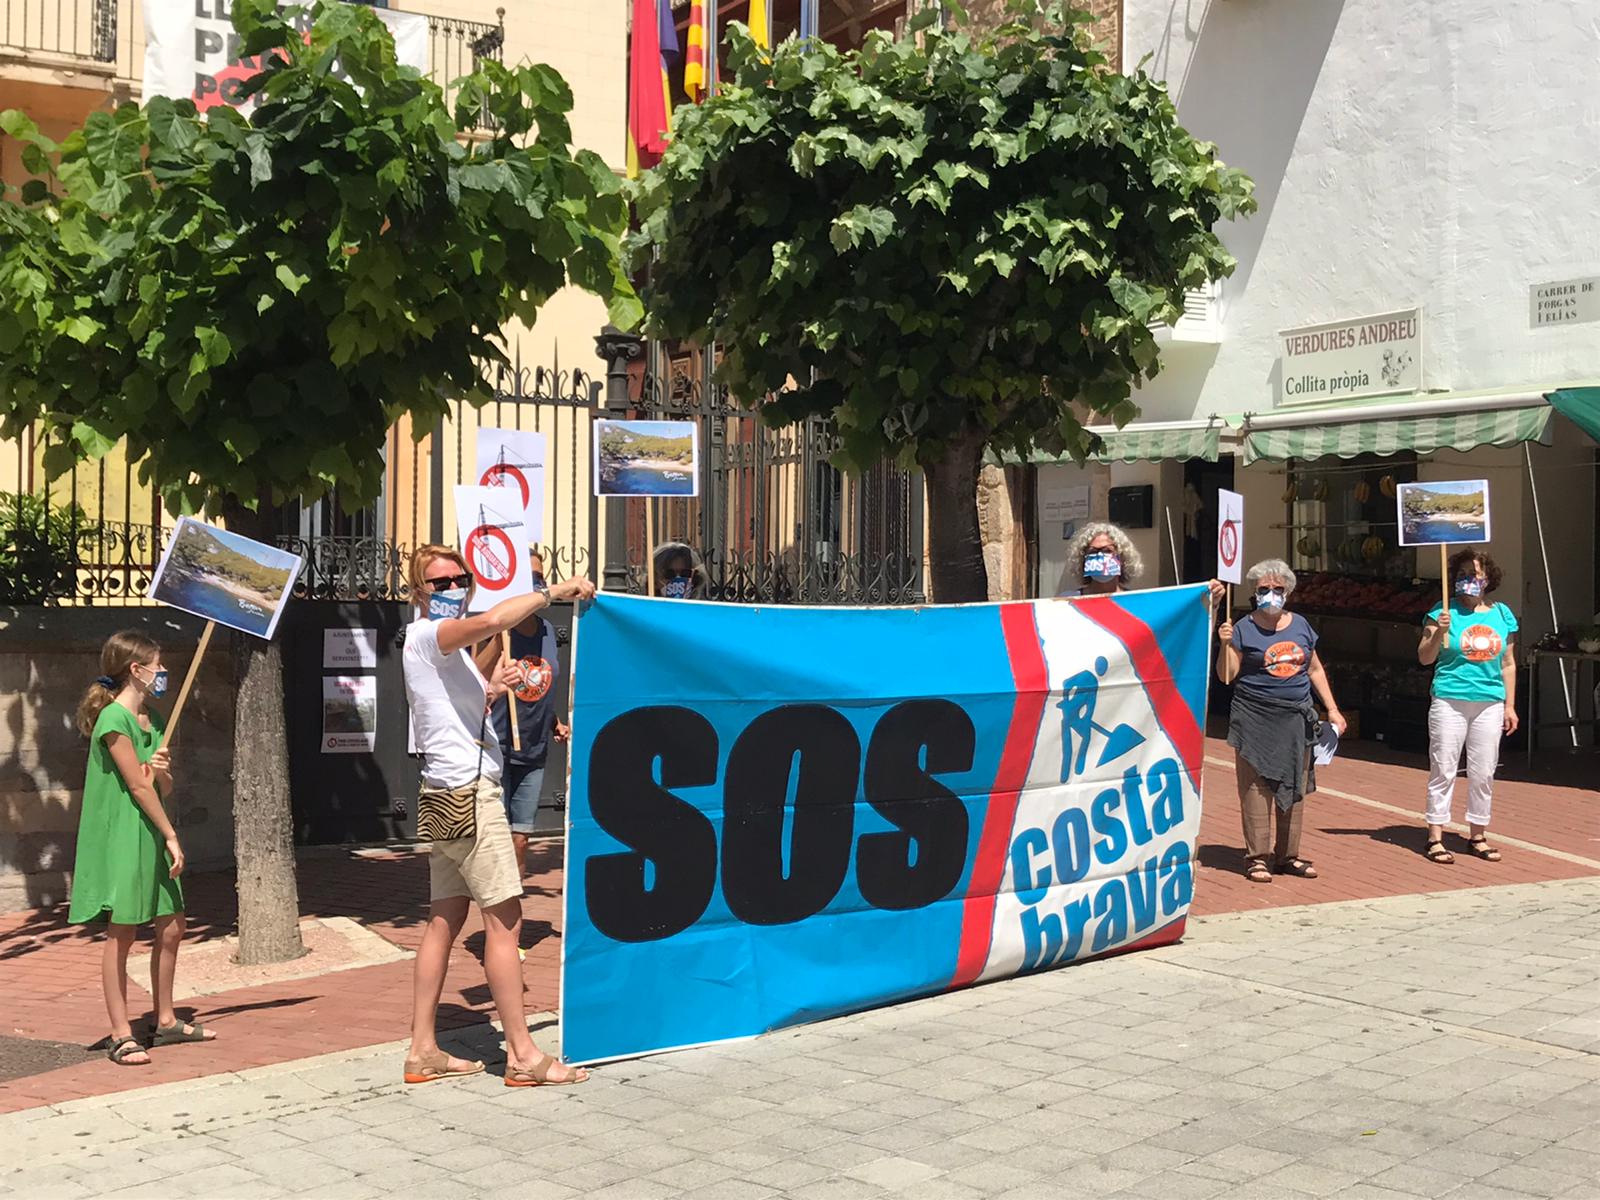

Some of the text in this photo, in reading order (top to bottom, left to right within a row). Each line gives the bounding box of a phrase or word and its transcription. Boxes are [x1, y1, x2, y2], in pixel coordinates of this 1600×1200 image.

[1537, 282, 1594, 298] CARRER DE
[1537, 298, 1577, 311] FORGAS
[1286, 318, 1417, 357] VERDURES ANDREU
[1285, 370, 1369, 395] Collita pròpia
[1084, 558, 1104, 572] SOS
[430, 599, 460, 618] SOS
[155, 676, 167, 692] SO
[585, 698, 976, 943] SOS
[1011, 758, 1184, 905] costa
[1017, 841, 1193, 975] brava
